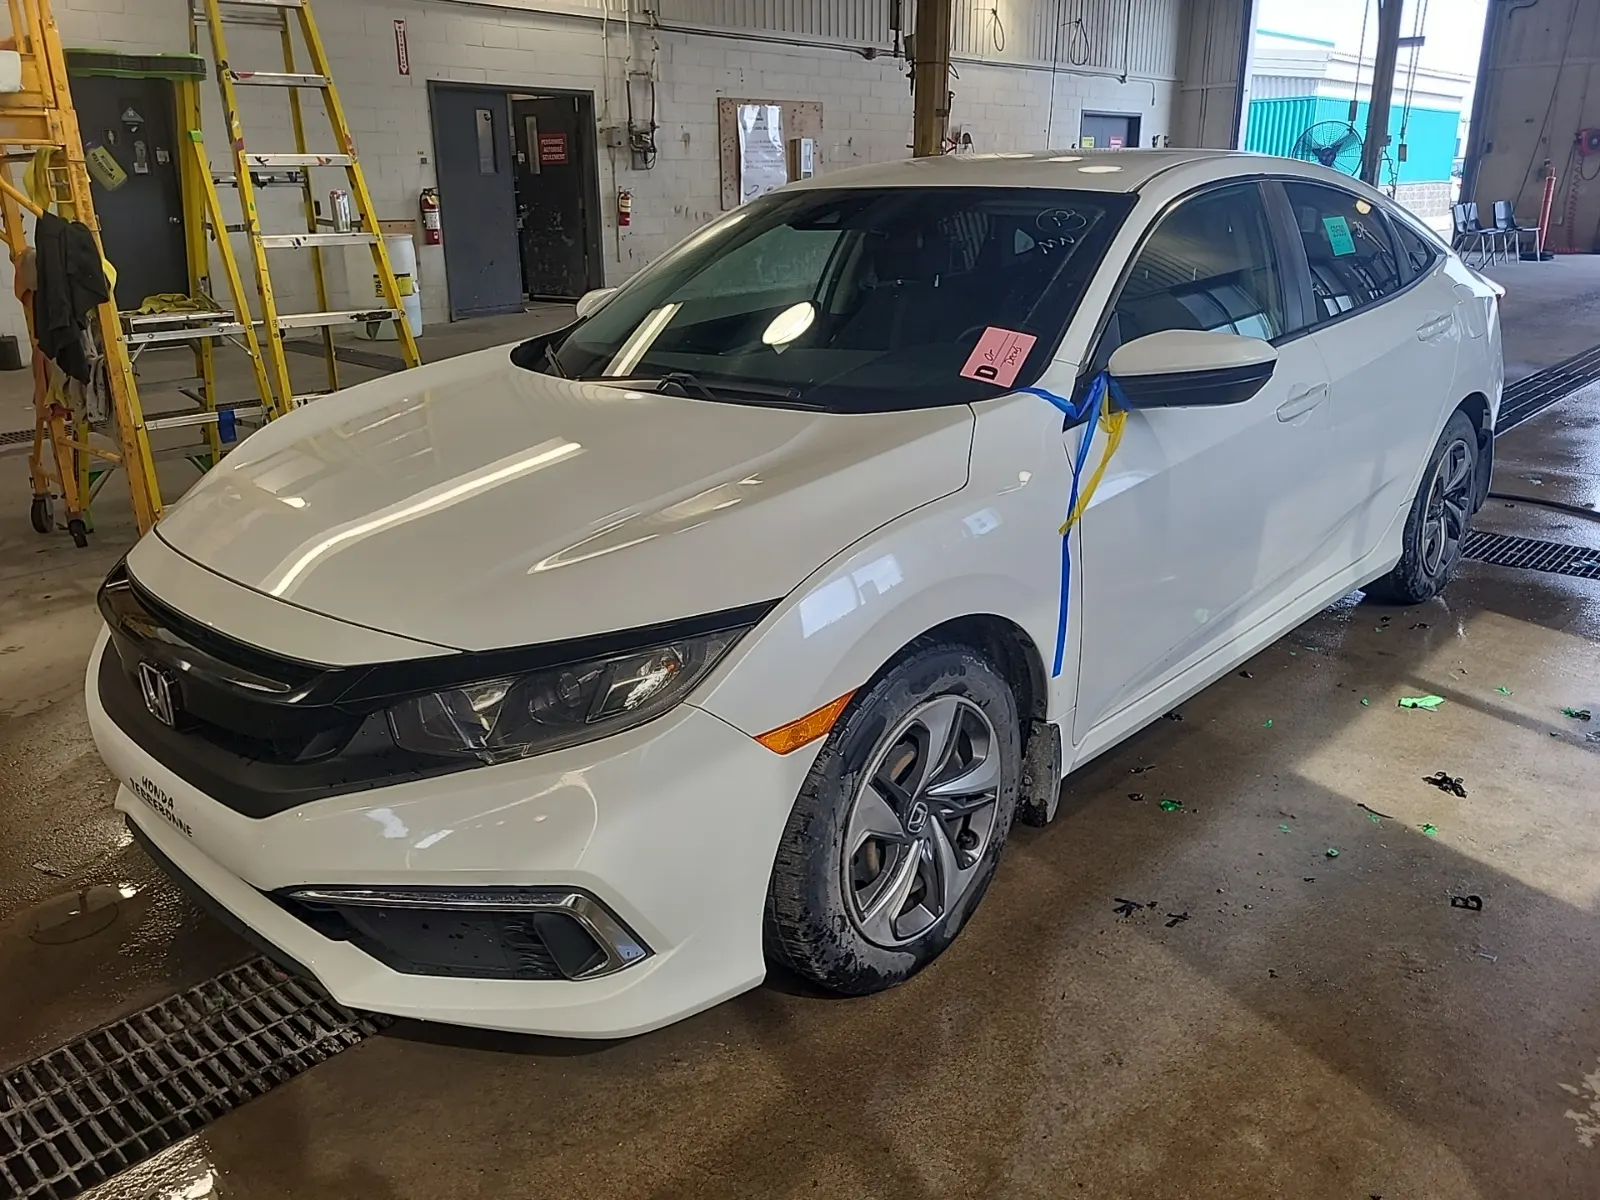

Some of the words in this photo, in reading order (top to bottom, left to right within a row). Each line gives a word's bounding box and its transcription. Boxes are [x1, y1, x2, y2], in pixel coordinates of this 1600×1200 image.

[973, 365, 999, 381] D
[129, 776, 193, 838] TERREBONNE
[141, 775, 174, 810] HONDA
